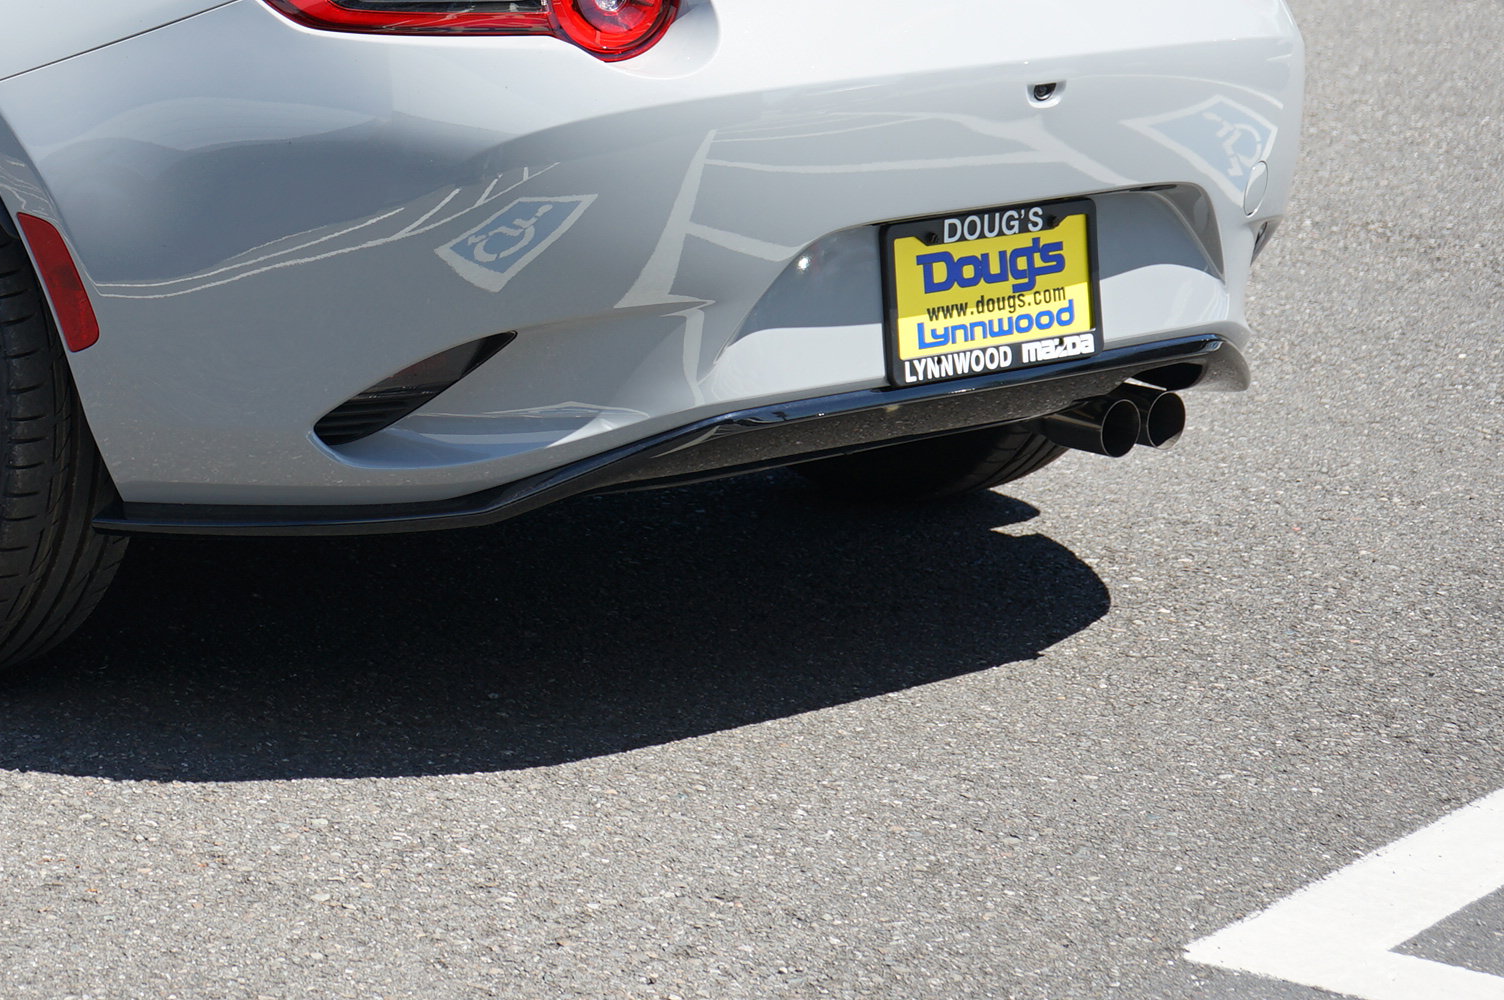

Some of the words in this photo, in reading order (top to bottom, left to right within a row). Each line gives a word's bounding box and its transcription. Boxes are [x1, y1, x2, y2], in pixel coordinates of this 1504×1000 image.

[943, 206, 1044, 244] DOUG'S
[926, 286, 1067, 322] www.dougs.com
[917, 298, 1075, 350] Lynnwood
[904, 345, 1012, 383] LYNNWOOD
